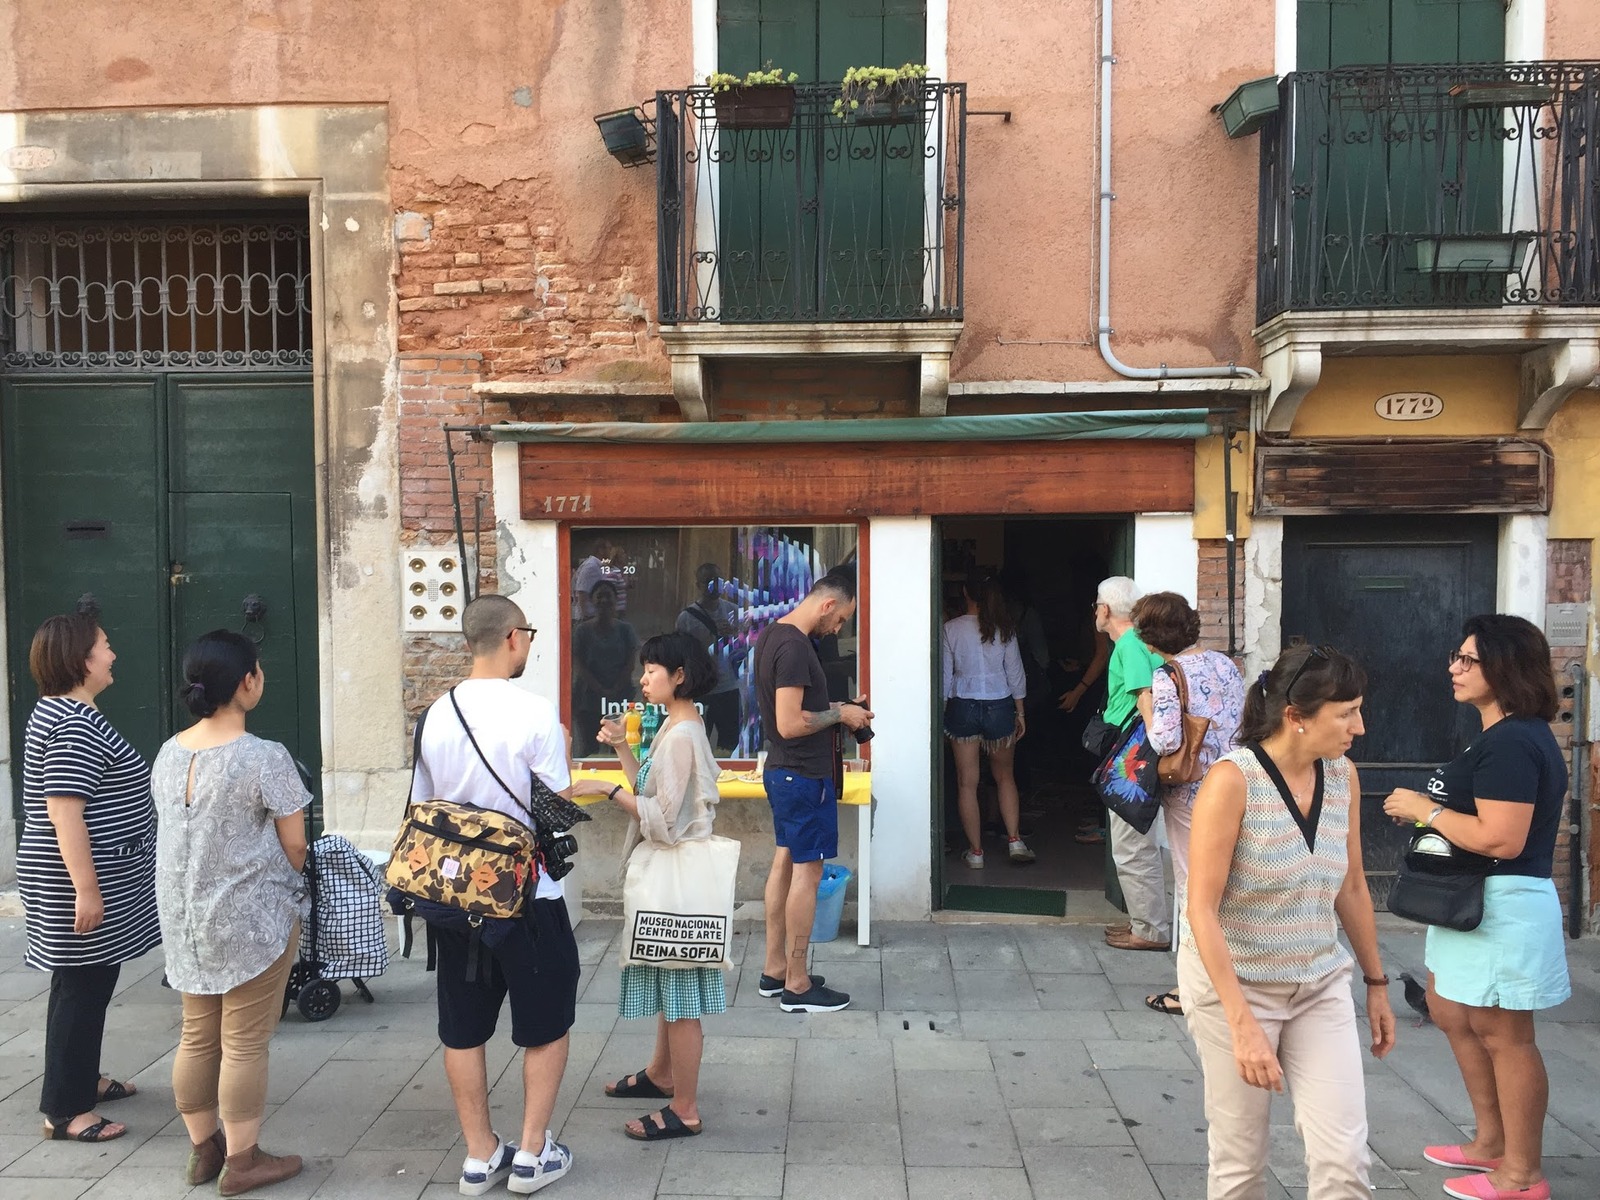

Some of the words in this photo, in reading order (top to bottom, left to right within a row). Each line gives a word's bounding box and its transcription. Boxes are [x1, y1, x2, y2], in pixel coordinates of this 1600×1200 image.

[1386, 397, 1434, 414] 1772
[544, 495, 591, 512] 1771
[600, 566, 611, 575] 13
[623, 566, 636, 575] 20
[639, 916, 674, 928] MUSEO
[675, 919, 722, 930] NACIONAL
[638, 927, 679, 939] CENTRO
[681, 930, 694, 939] DE
[696, 931, 722, 940] ARTE
[635, 943, 677, 957] REINA
[680, 947, 719, 959] SOFIA
